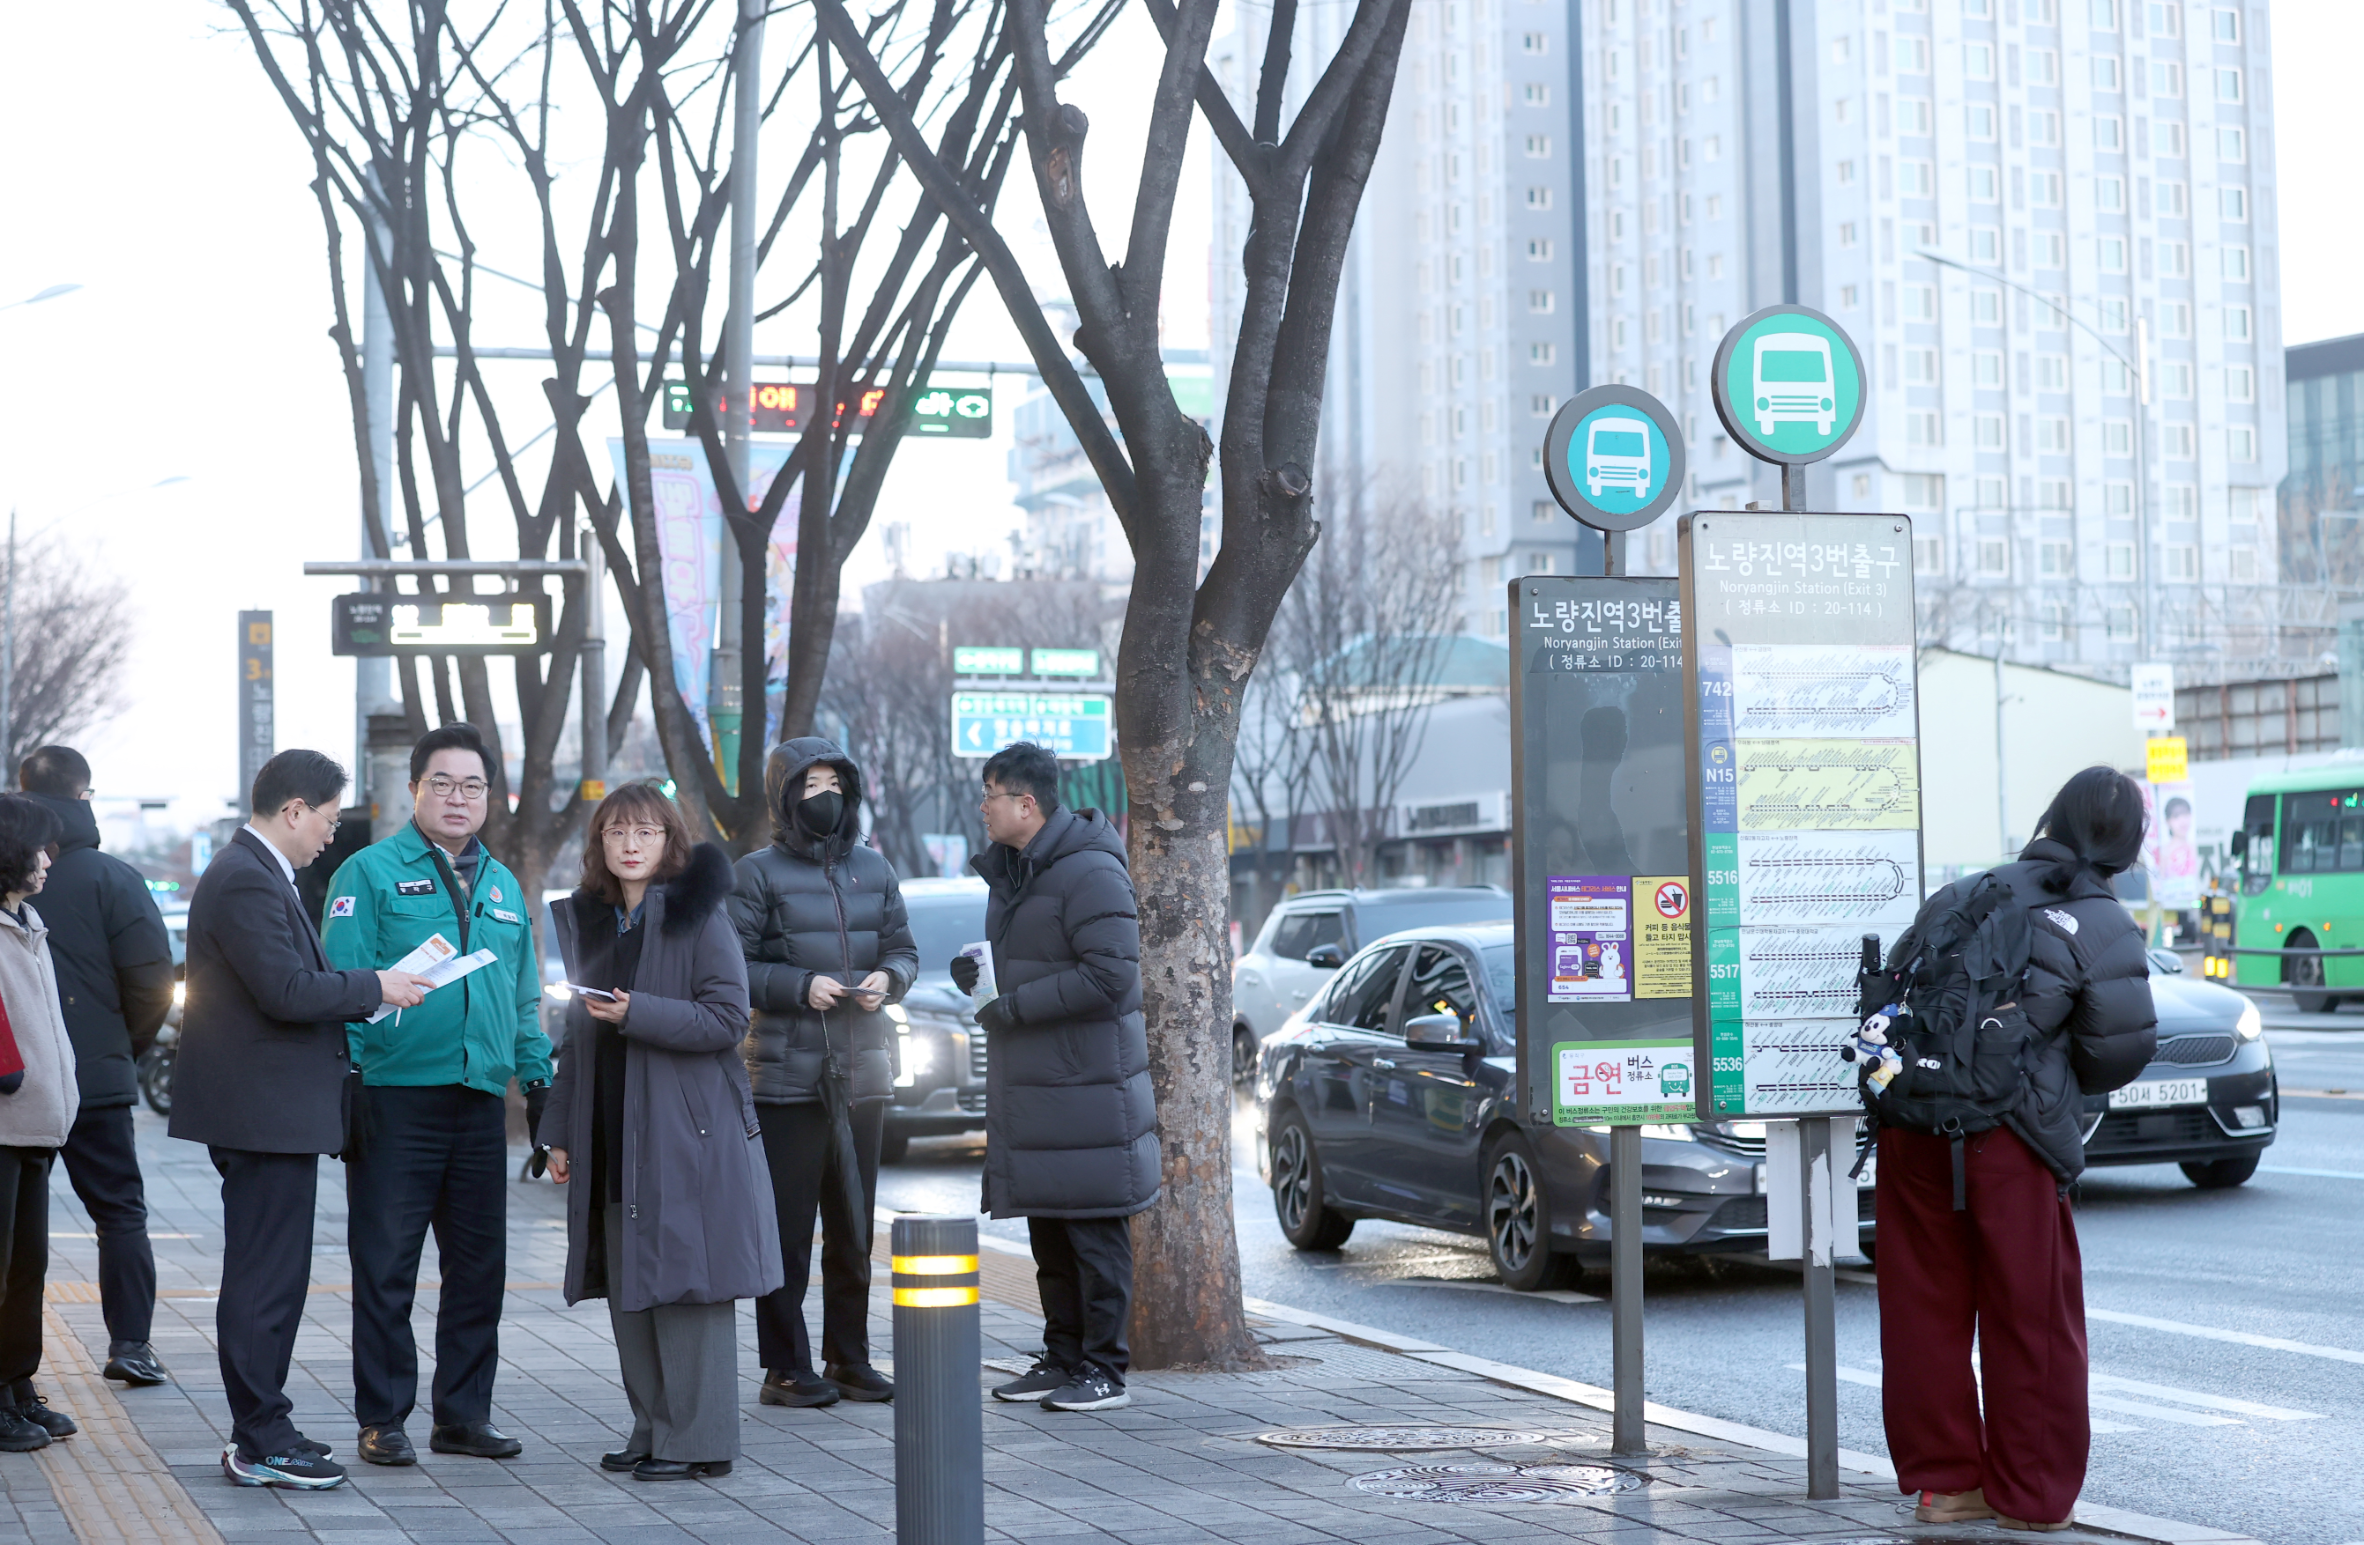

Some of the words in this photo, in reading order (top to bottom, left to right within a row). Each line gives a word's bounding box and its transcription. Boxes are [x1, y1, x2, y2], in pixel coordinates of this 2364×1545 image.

[1704, 541, 1900, 579] 노량진역3번출구
[1719, 580, 1789, 596] Noryangjin
[1794, 581, 1840, 595] Station
[1843, 582, 1871, 597] (Exit
[1875, 583, 1887, 597] 3)
[1738, 599, 1782, 616] 정류소
[1789, 601, 1805, 614] ID
[1824, 601, 1872, 615] 20-114
[1544, 637, 1608, 651] Noryangjin
[1613, 637, 1655, 649] Station
[1561, 654, 1601, 670] 정류소
[1608, 655, 1623, 668] ID
[1703, 681, 1732, 697] 742
[1706, 768, 1734, 783] N15
[1708, 870, 1738, 885] 5516
[1661, 933, 1676, 941] 타지
[1710, 964, 1740, 979] 5517
[1627, 1054, 1654, 1070] 버스
[1713, 1057, 1743, 1072] 5536
[1568, 1061, 1622, 1095] 금연
[1627, 1070, 1654, 1082] 정류소
[2159, 1083, 2197, 1101] 5201
[1566, 1107, 1600, 1115] 버스정류소는
